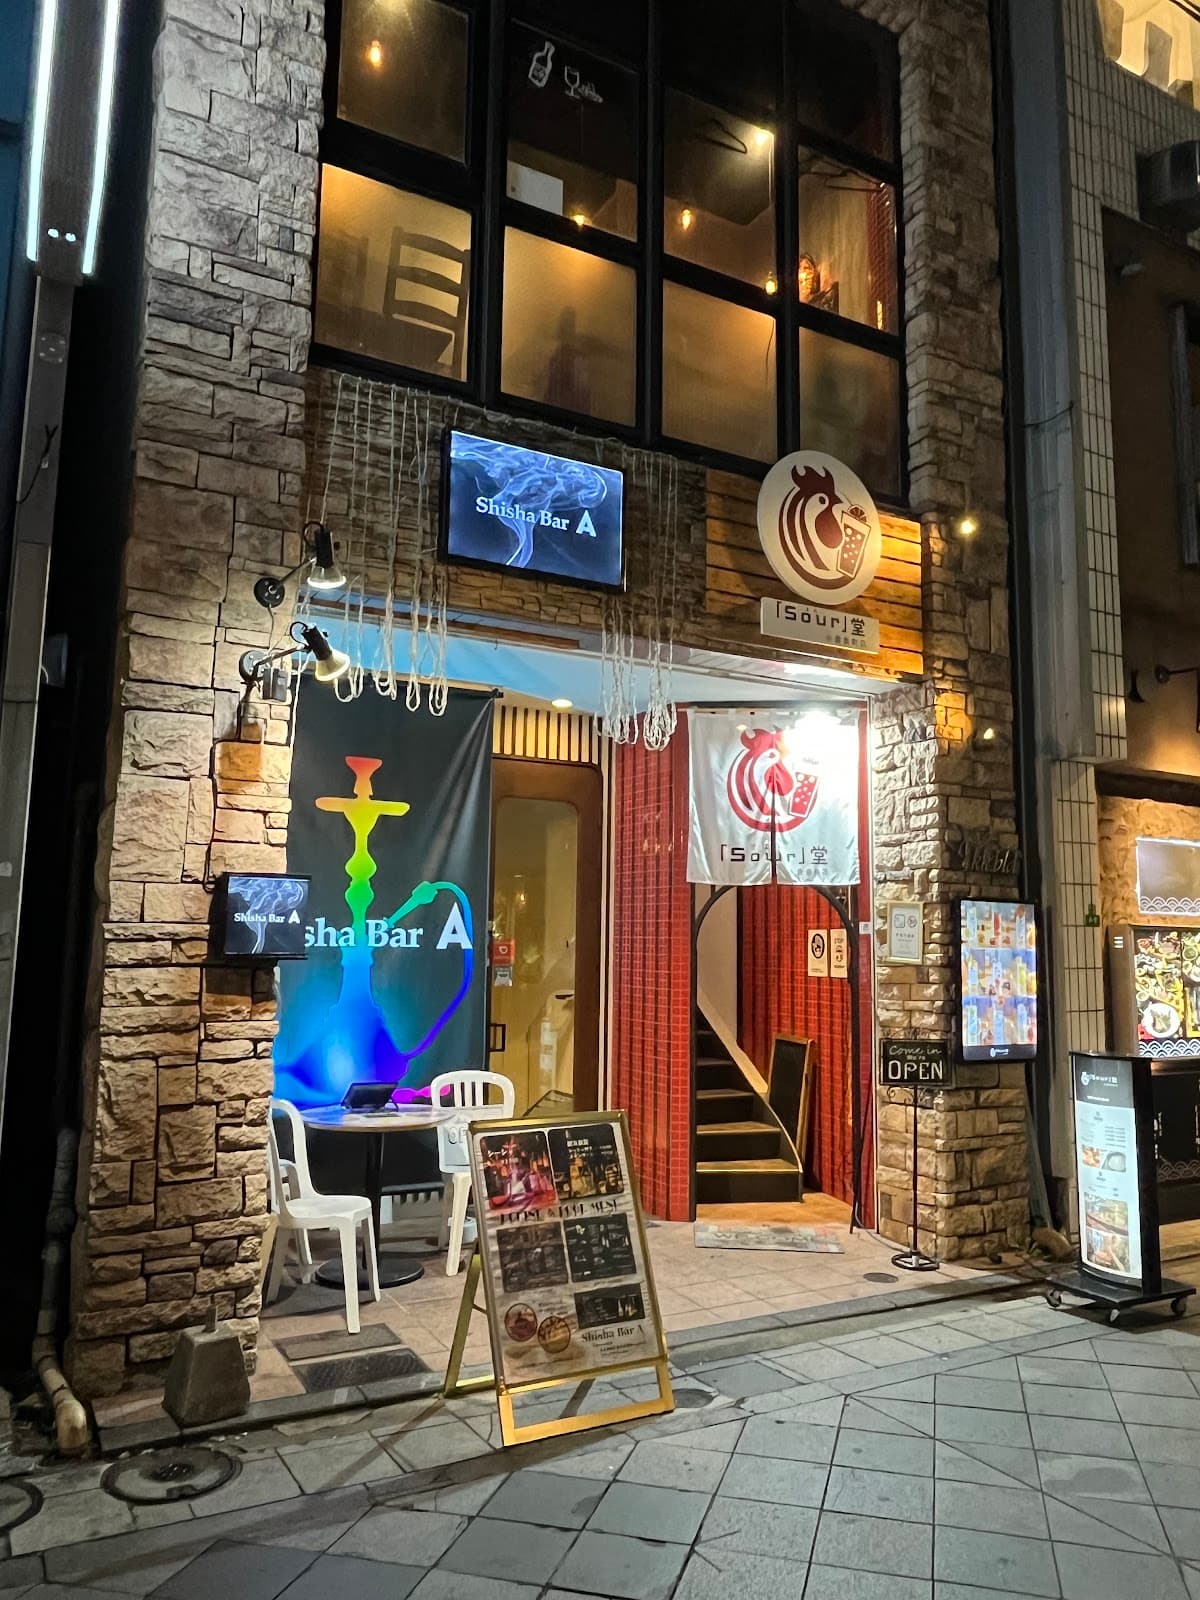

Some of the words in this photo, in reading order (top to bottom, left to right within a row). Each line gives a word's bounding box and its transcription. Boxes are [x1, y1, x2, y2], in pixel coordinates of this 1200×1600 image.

[475, 496, 536, 523] Shisha
[539, 510, 570, 530] Bar
[575, 509, 597, 537] A
[233, 912, 267, 922] Shisha
[268, 913, 285, 923] Bar
[288, 909, 301, 924] A
[366, 918, 424, 948] Bar
[436, 901, 473, 950] A
[889, 1045, 924, 1056] Come
[926, 1047, 942, 1055] in
[888, 1060, 943, 1080] OPEN
